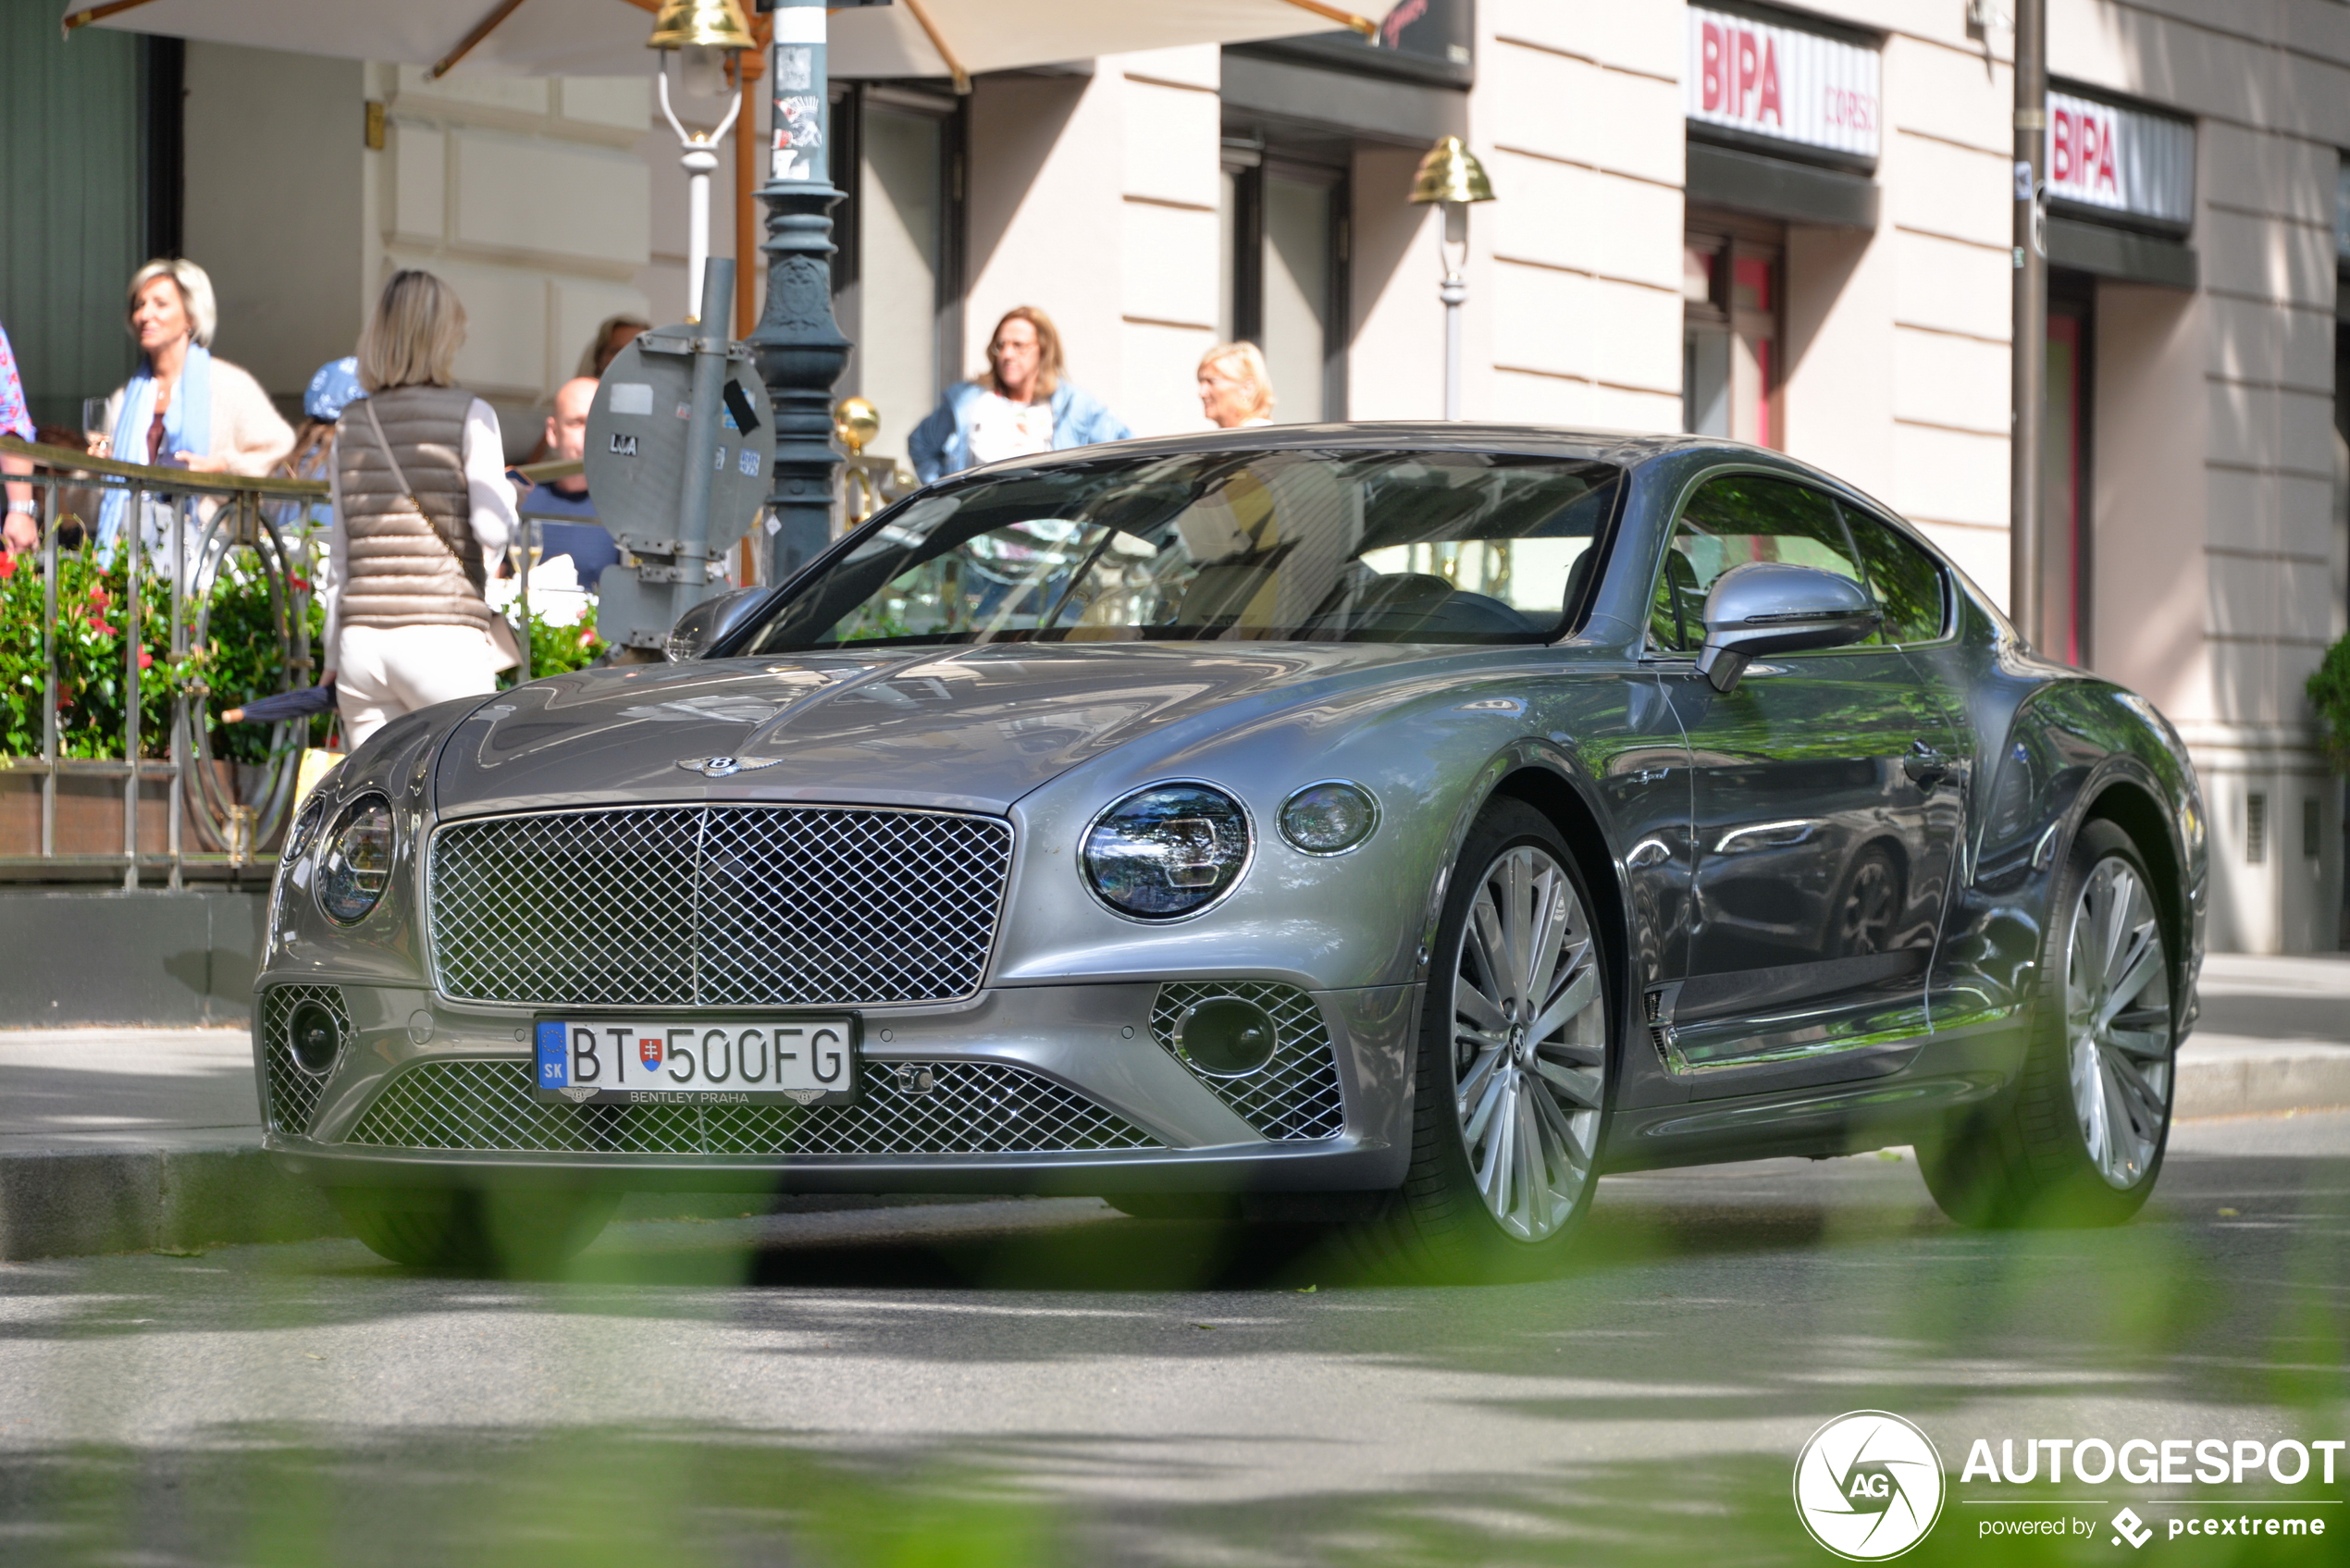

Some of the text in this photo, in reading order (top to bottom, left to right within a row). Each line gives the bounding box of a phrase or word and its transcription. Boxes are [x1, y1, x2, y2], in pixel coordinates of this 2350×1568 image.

[1701, 21, 1782, 127] BIPA
[2053, 109, 2118, 195] BIPA
[710, 757, 733, 769] B
[544, 1063, 563, 1079] SK
[572, 1027, 841, 1083] BT 500FG
[630, 1092, 749, 1104] BENTLEY PRAHA
